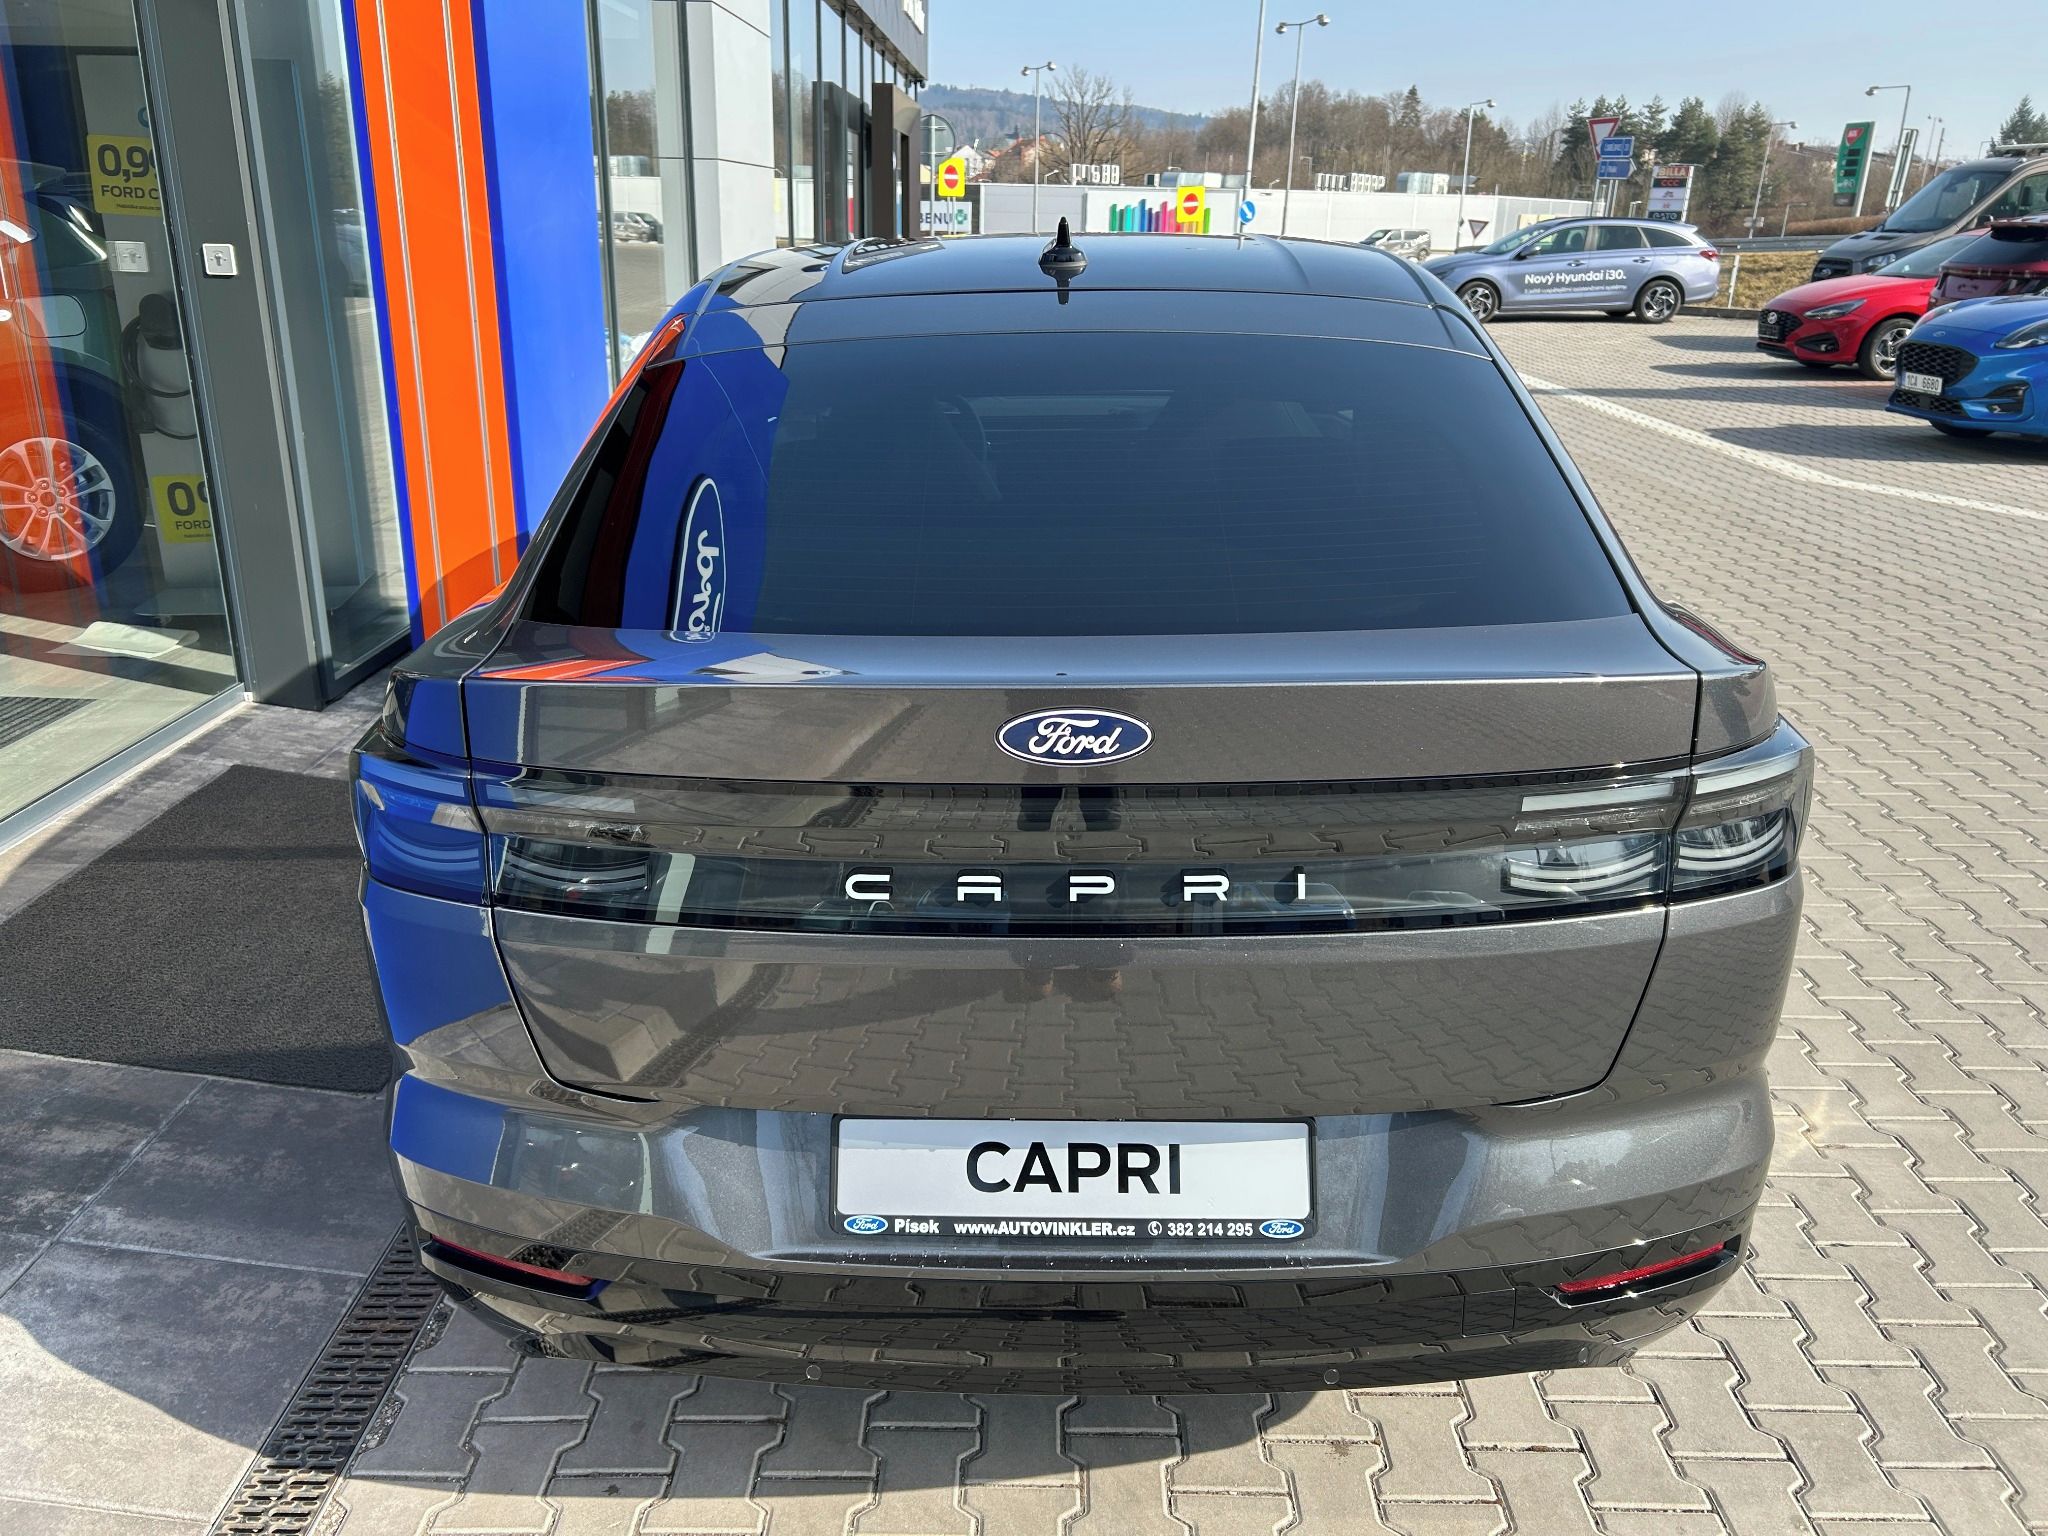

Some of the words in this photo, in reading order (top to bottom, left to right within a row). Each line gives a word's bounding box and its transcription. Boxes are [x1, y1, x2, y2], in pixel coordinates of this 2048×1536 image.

[1658, 167, 1687, 176] BILLA
[101, 185, 145, 198] FORD
[1524, 272, 1555, 285] Nový
[1556, 269, 1604, 284] Hyundai
[175, 520, 211, 530] FORD
[1028, 716, 1123, 755] Ford
[845, 873, 1306, 902] CAPRI
[966, 1141, 1181, 1194] CAPRI
[852, 1217, 880, 1231] Ford
[894, 1218, 940, 1234] Písek
[954, 1220, 1136, 1237] www.AUTOVINKLER.cz
[1167, 1222, 1196, 1236] 382
[1198, 1222, 1225, 1236] 214
[1227, 1222, 1254, 1237] 295
[1268, 1221, 1296, 1235] Ford
